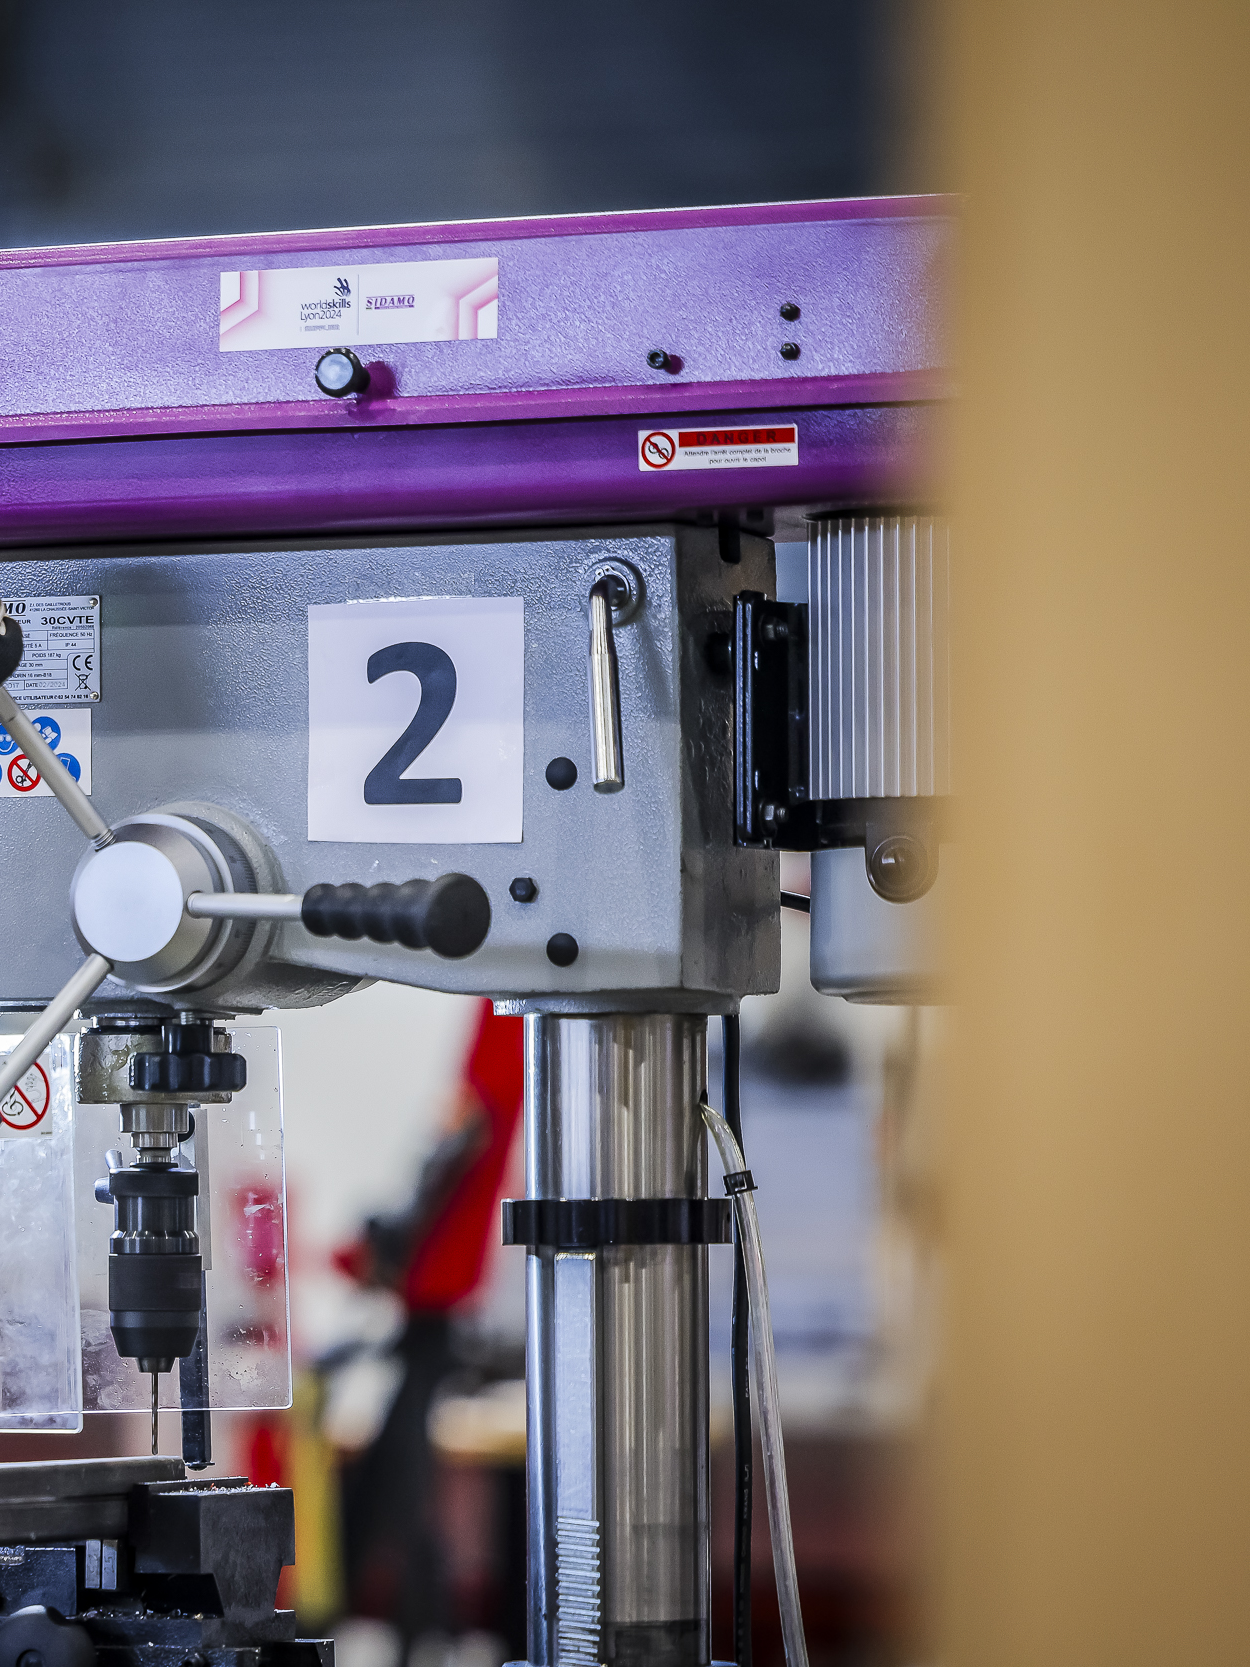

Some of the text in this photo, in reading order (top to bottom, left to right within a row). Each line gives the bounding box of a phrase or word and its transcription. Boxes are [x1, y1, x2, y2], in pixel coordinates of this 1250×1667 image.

[301, 299, 351, 311] worldskills
[366, 296, 415, 308] SIDAMO
[300, 309, 342, 322] Lyon2024
[697, 431, 777, 445] DANGER
[729, 449, 753, 457] complet
[4, 602, 26, 614] MO
[41, 615, 94, 625] 30CVTE
[364, 641, 463, 805] 2
